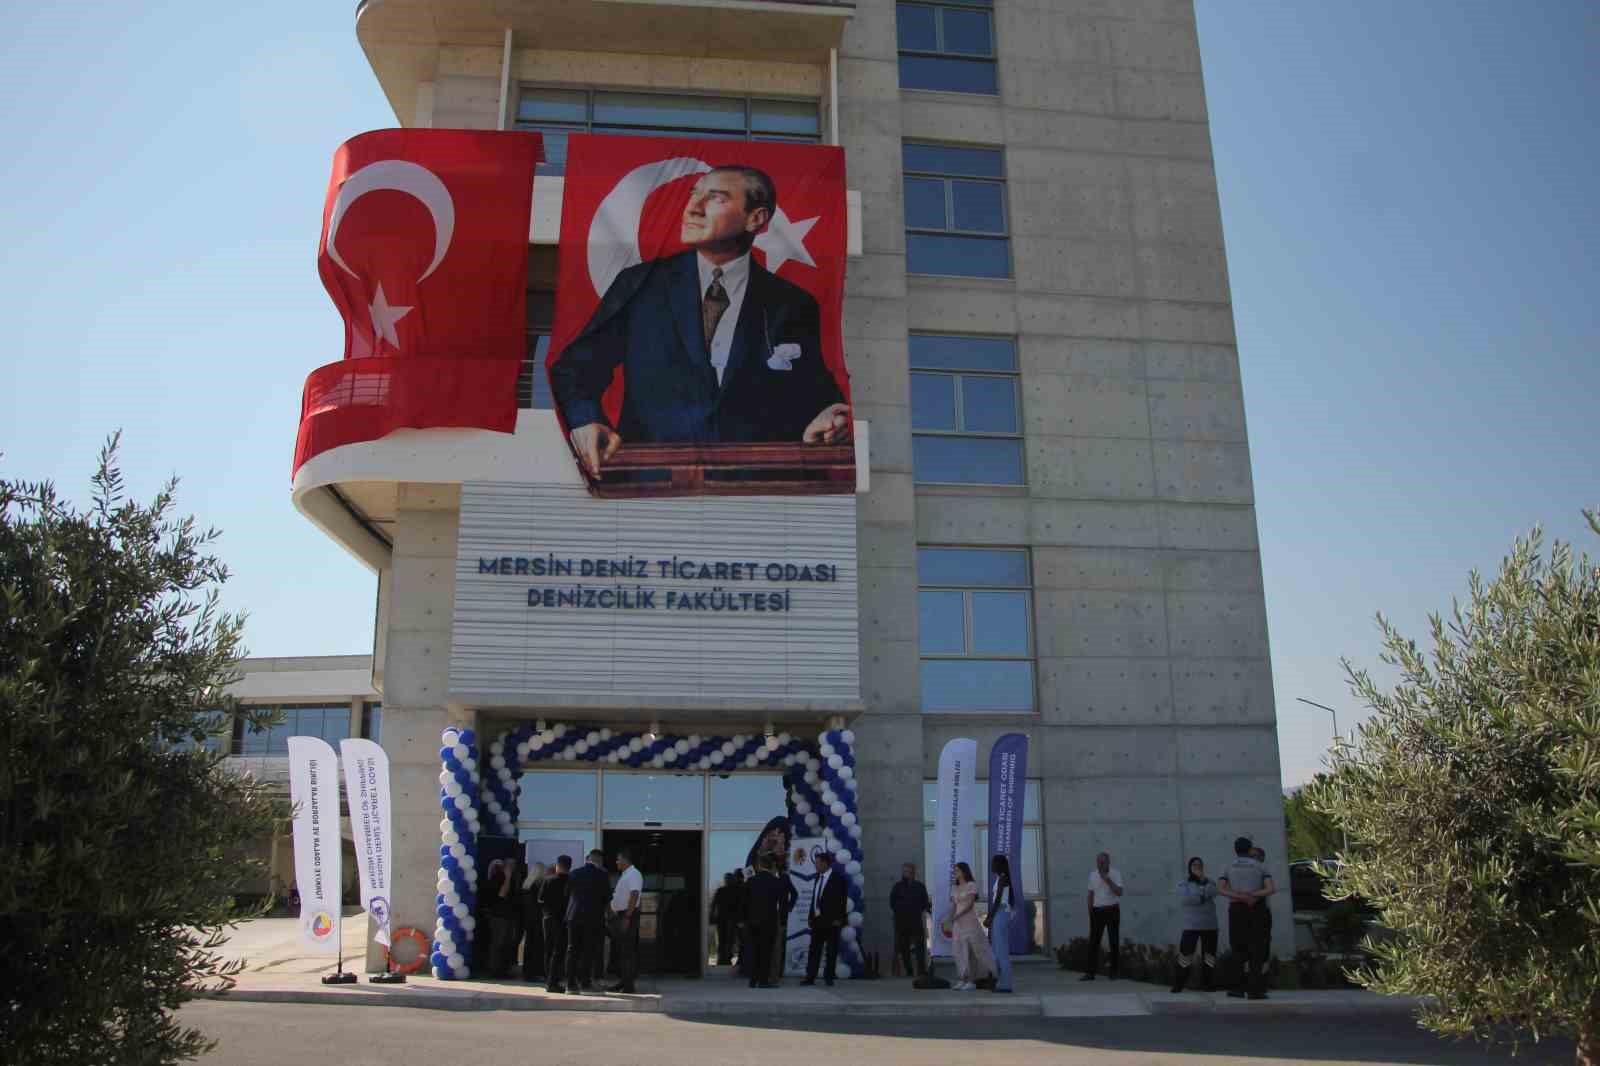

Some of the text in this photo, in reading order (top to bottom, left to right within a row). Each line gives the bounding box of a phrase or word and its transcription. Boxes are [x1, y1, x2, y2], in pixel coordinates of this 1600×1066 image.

[479, 552, 836, 583] MERSİN DENİZ TİCARET ODASI
[527, 583, 790, 612] DENİZCİLİK FAKÜLTESİ
